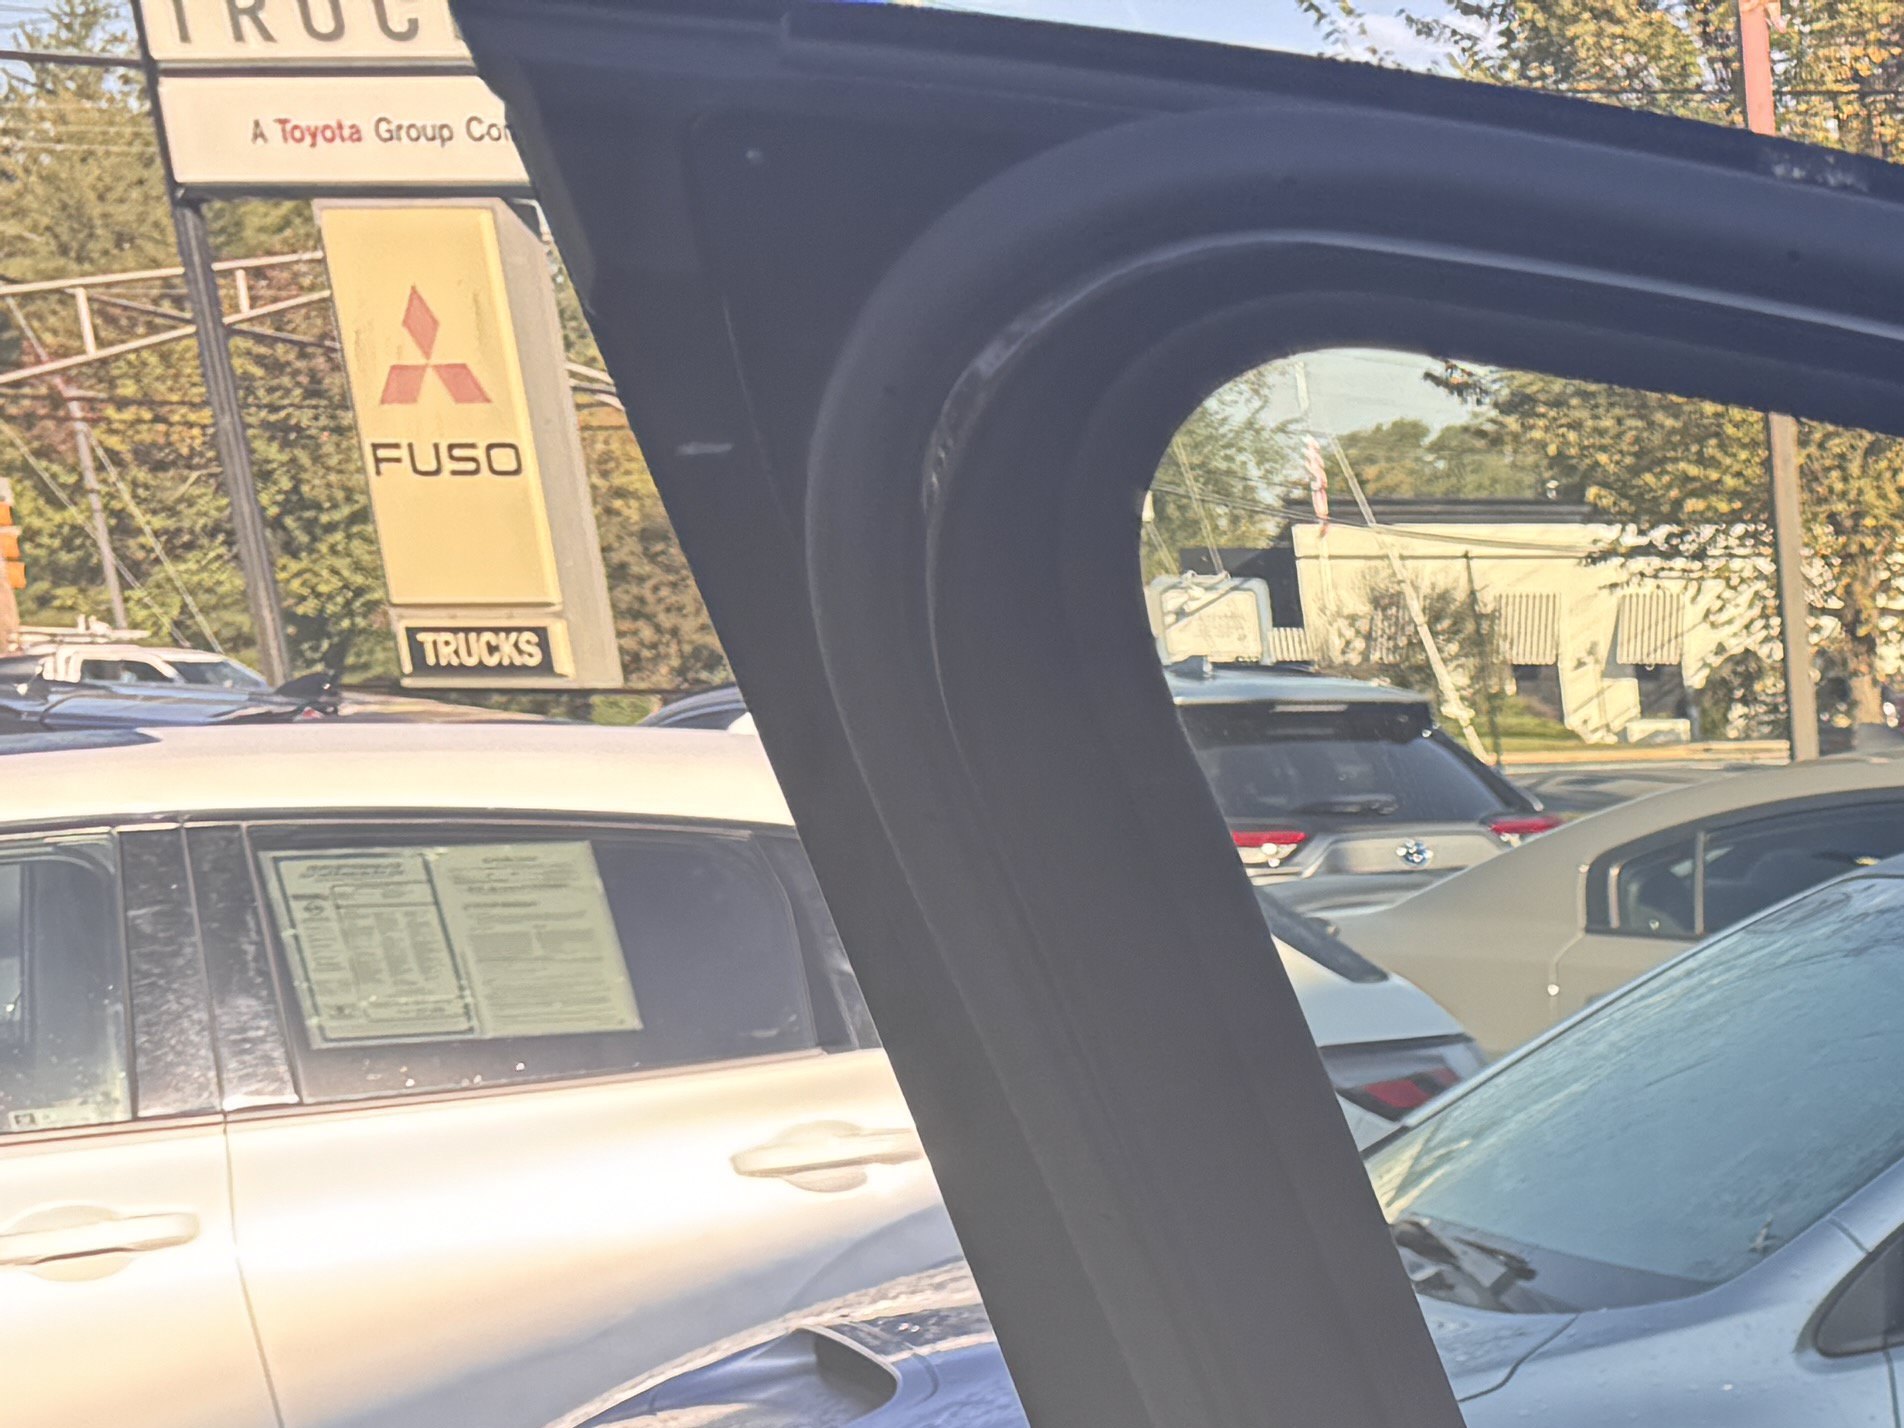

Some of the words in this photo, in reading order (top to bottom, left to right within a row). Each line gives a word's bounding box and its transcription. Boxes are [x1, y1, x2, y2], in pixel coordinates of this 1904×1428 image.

[251, 118, 268, 145] A
[274, 117, 363, 148] Toyota
[374, 116, 455, 148] Group
[371, 441, 523, 477] FUSO
[416, 631, 543, 668] TRUCKS
